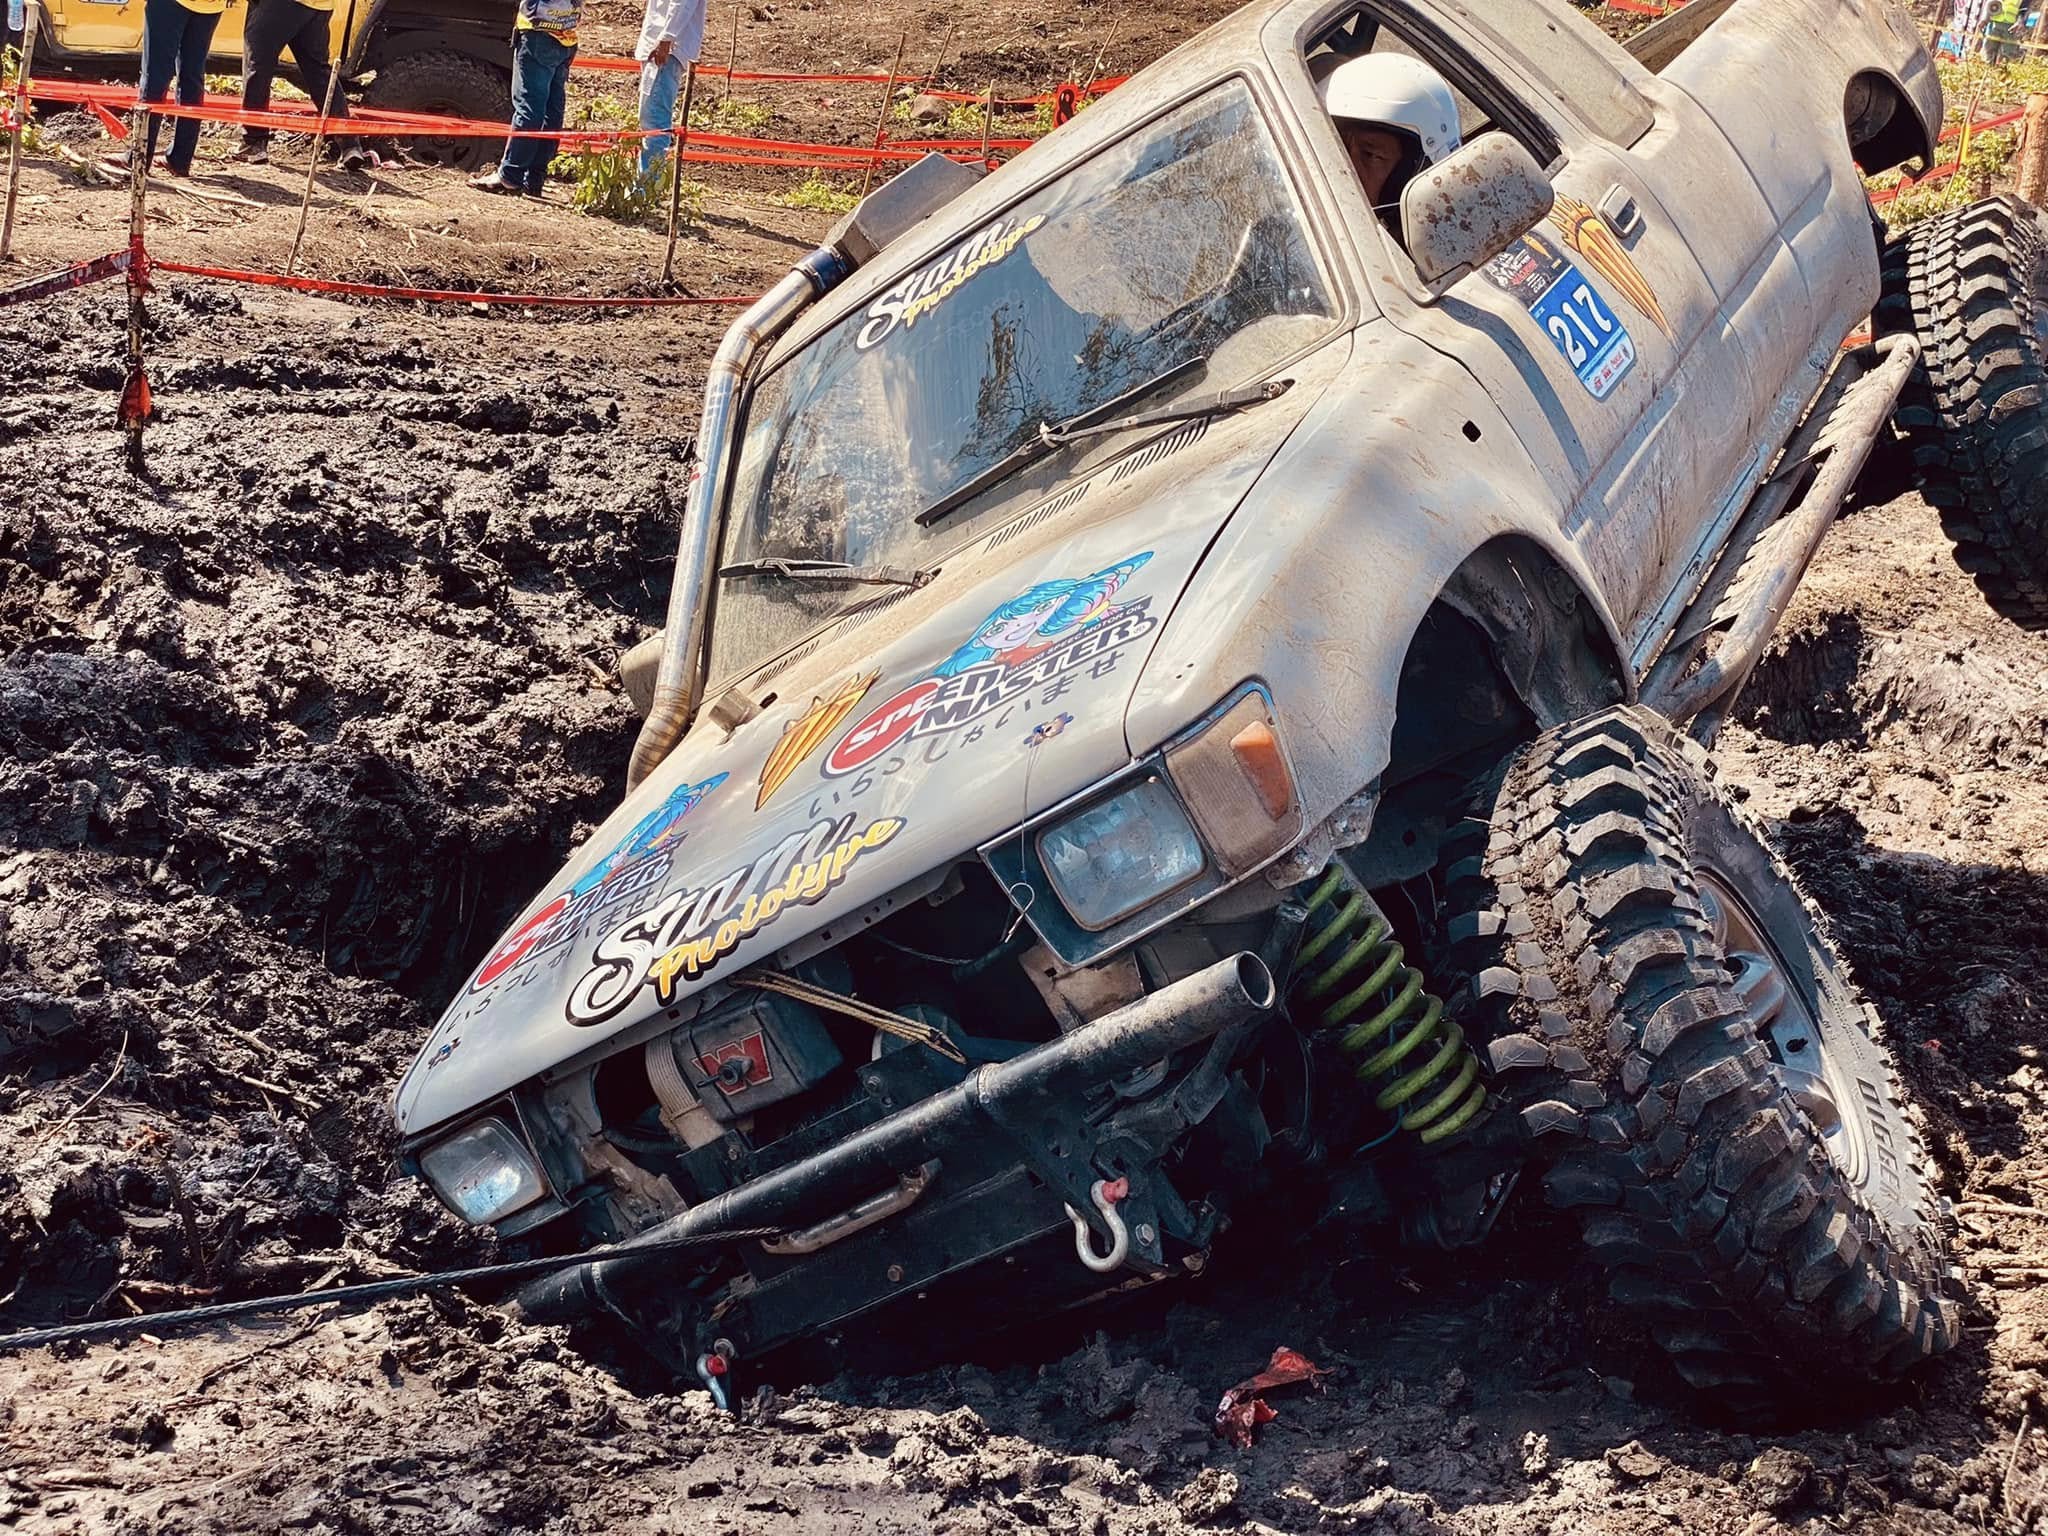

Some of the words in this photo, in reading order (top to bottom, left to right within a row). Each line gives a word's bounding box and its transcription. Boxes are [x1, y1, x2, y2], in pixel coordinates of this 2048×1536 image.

[856, 217, 1017, 349] Siam
[1547, 283, 1613, 369] 217
[1126, 604, 1144, 615] OIL
[843, 667, 1005, 757] SPEED
[912, 613, 1156, 737] MASTER
[567, 812, 857, 1026] Siam
